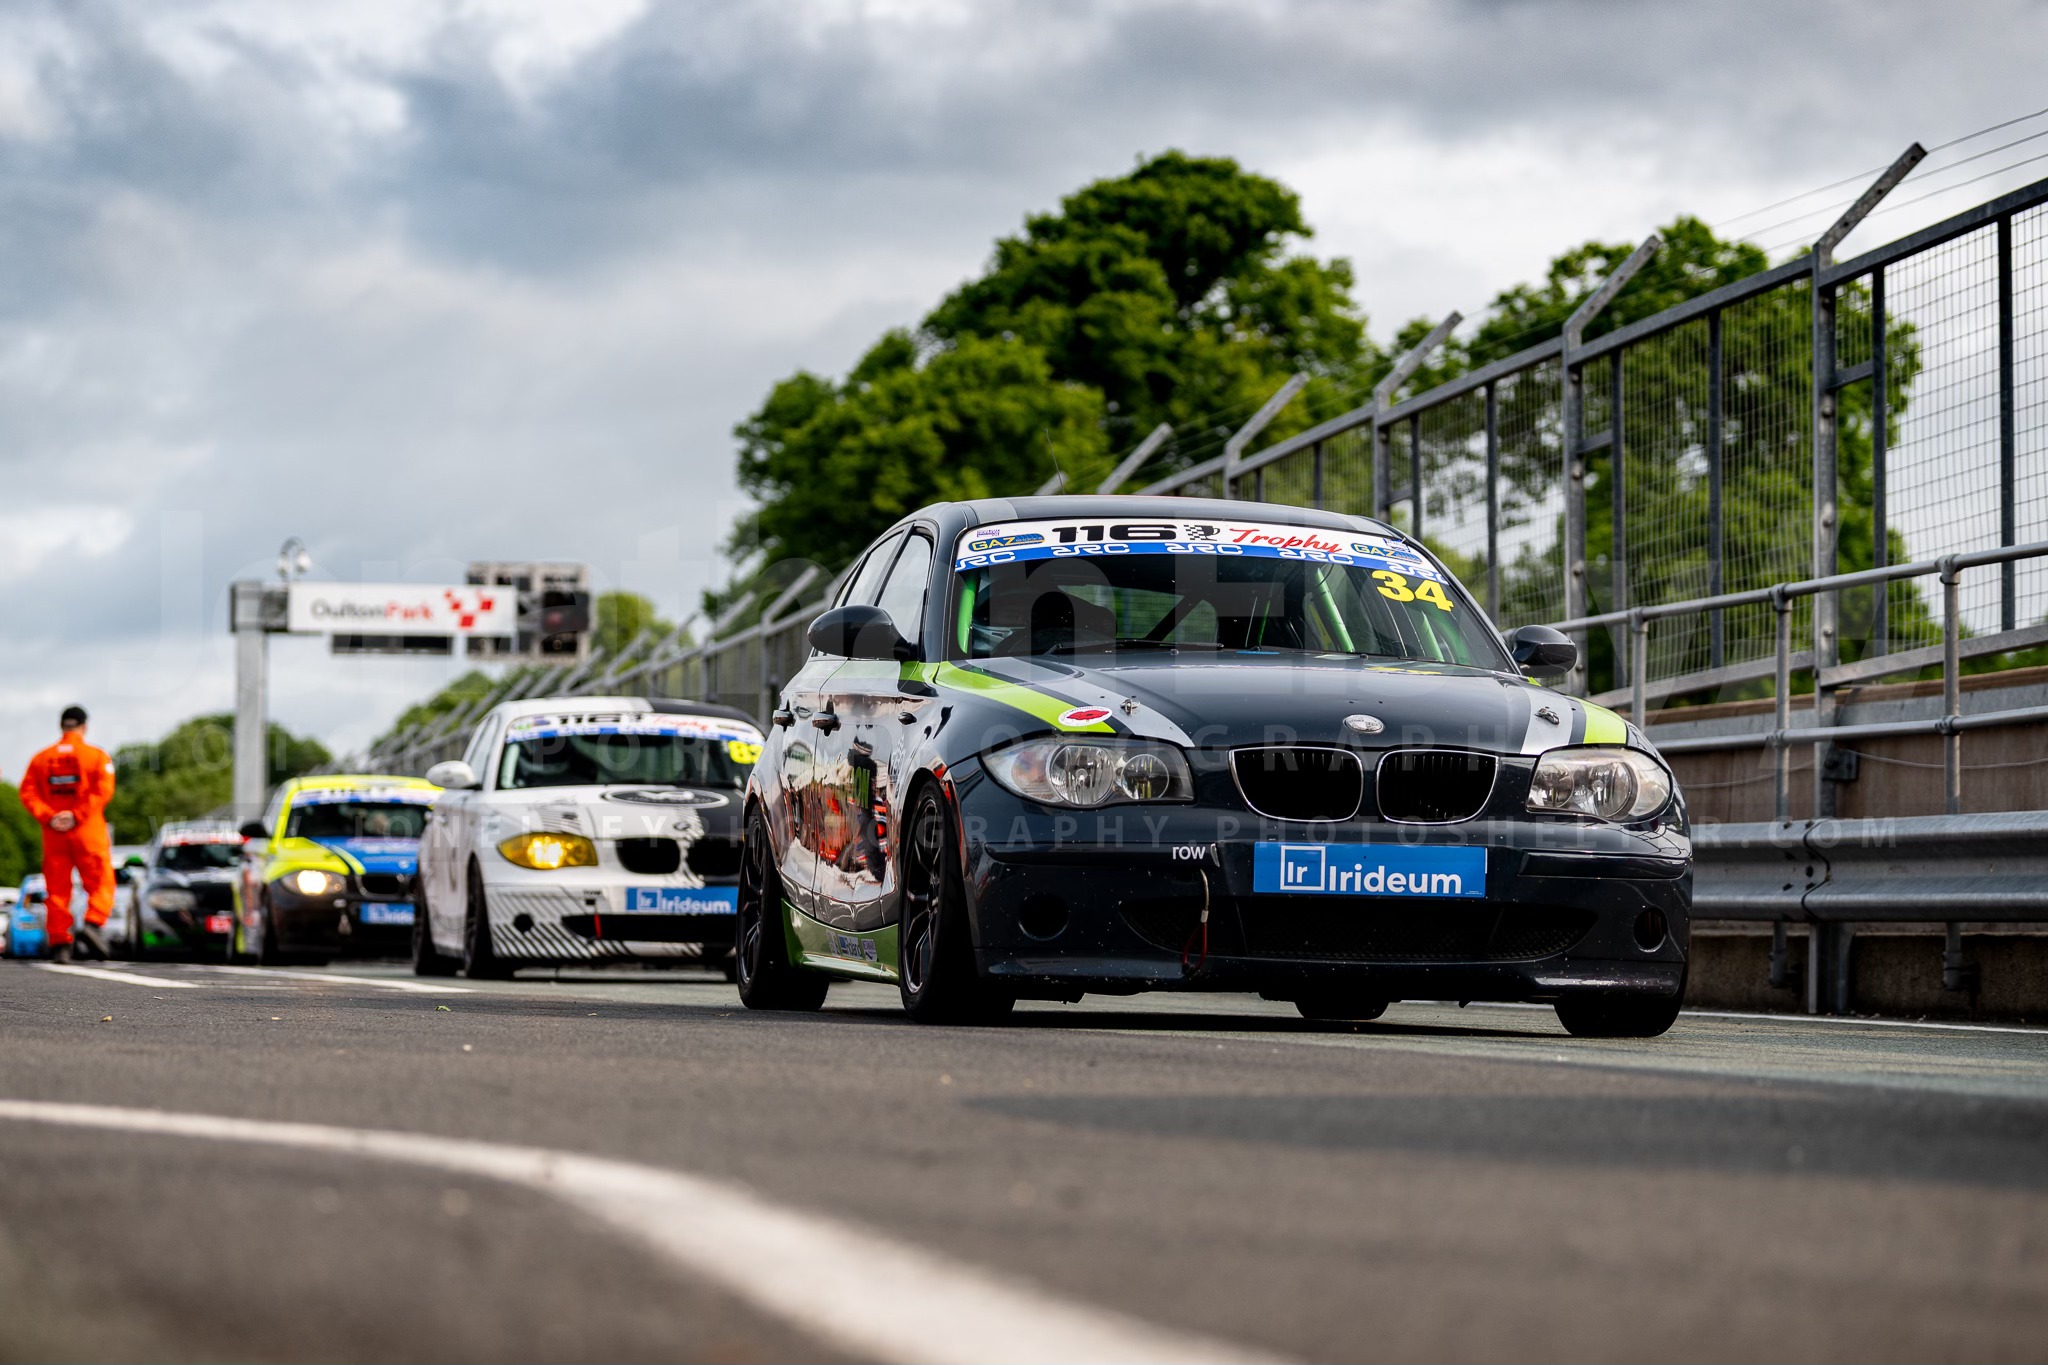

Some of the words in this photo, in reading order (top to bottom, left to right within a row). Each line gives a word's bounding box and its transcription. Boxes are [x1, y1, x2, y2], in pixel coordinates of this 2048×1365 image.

[971, 536, 1016, 551] GAZ
[1051, 524, 1177, 543] 116
[1229, 527, 1343, 553] Trophy
[1353, 543, 1396, 557] GAZ
[1370, 569, 1455, 612] 34
[1287, 861, 1308, 884] Ir
[1329, 863, 1462, 894] Irideum
[661, 896, 732, 914] Irideum
